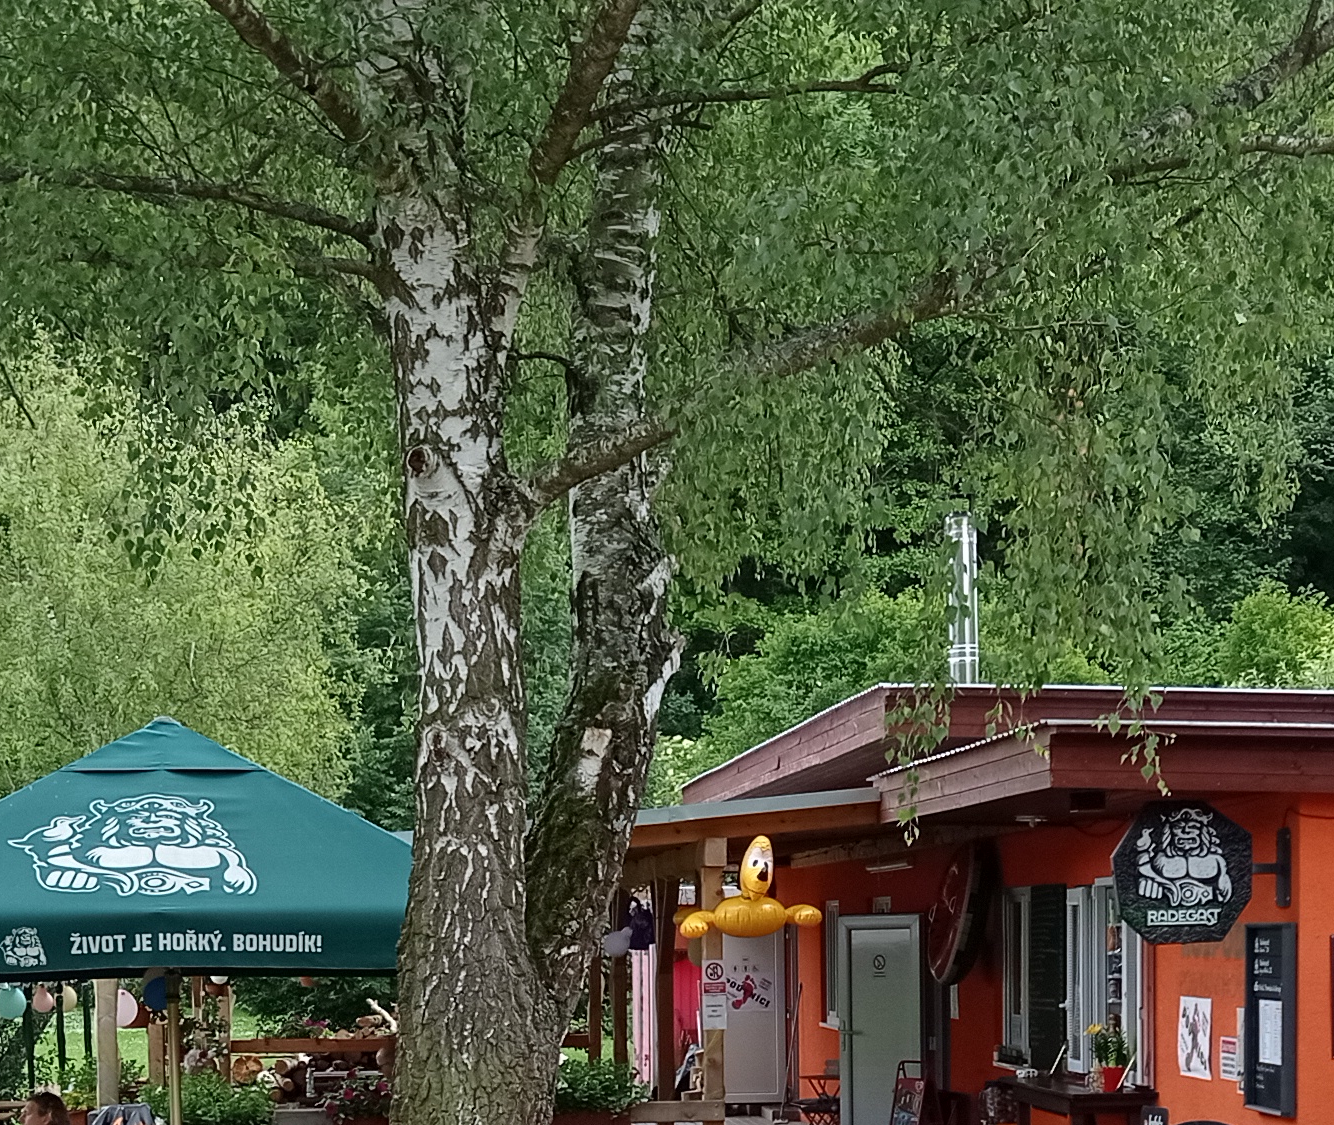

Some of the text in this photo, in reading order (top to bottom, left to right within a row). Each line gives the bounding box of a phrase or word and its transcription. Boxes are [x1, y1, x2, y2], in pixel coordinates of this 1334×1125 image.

[1147, 908, 1222, 926] RADEGAST
[69, 929, 323, 955] ŽIVOT JE HOŘKÝ. BOHUDÍK!
